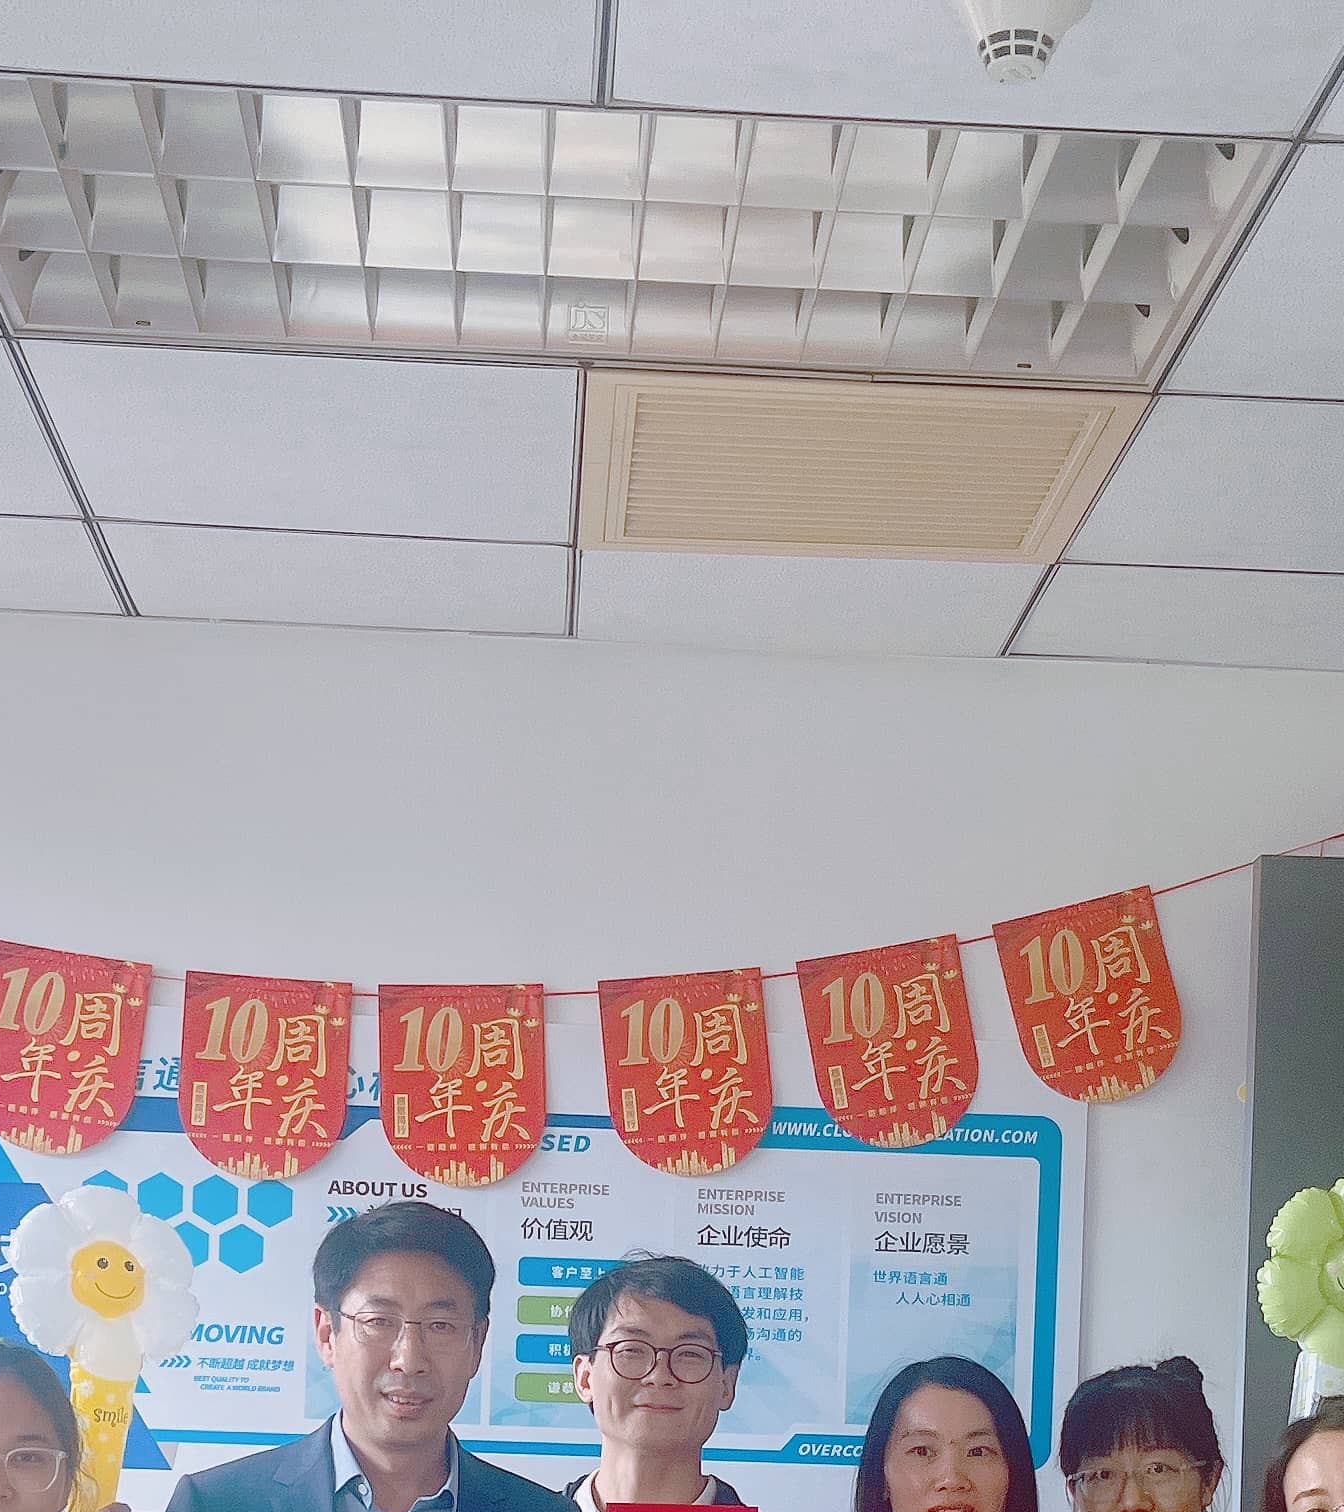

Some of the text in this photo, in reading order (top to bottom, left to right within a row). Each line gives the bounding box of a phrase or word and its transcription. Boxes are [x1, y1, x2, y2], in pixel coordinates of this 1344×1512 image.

[328, 1180, 428, 1198] ABOUT US
[521, 1181, 610, 1197] ENTERPRISE
[698, 1188, 786, 1204] ENTERPRISE
[521, 1196, 575, 1210] VALUES
[875, 1192, 962, 1208] ENTERPRISE
[697, 1203, 755, 1217] MISSION
[874, 1211, 923, 1225] VISION
[521, 1217, 594, 1243] 价值观
[697, 1224, 792, 1250] 企业使命
[874, 1230, 970, 1256] 企业愿景
[872, 1269, 949, 1287] 世界语言通
[896, 1291, 971, 1308] 人人心相通
